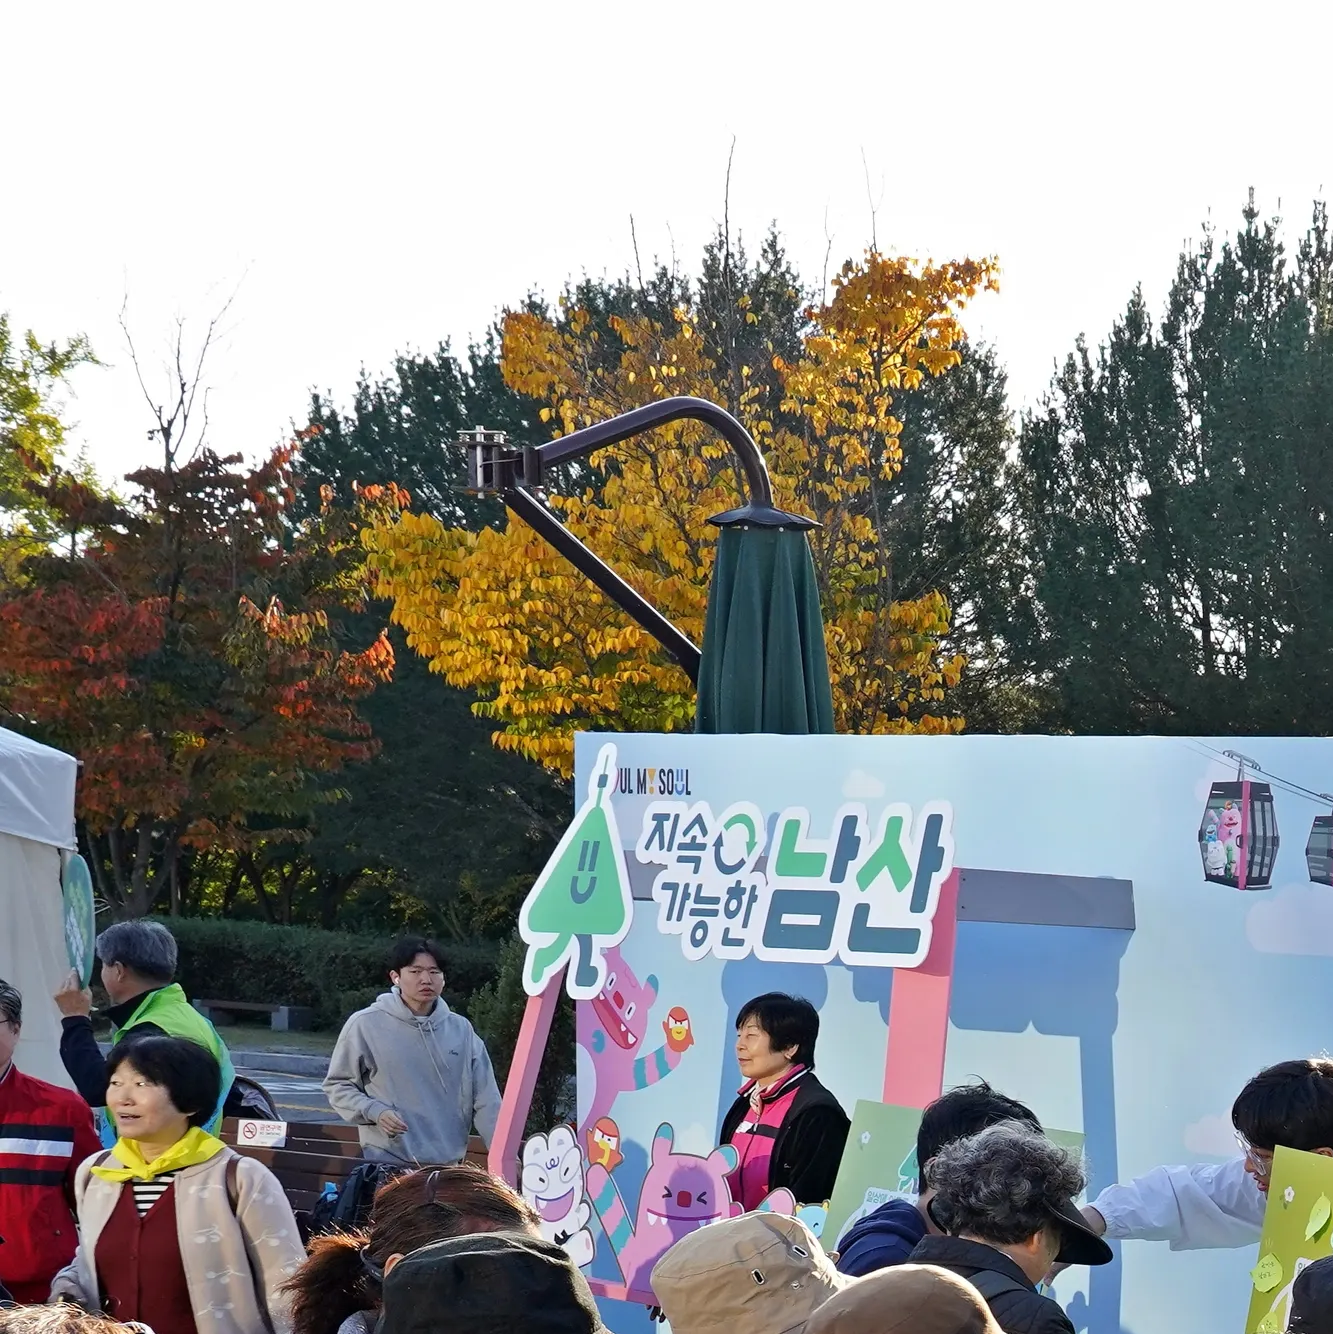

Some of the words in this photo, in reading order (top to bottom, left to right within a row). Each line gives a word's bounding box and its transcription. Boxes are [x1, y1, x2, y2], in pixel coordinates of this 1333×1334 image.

[659, 768, 691, 795] SOUL
[645, 812, 708, 874] 지속
[661, 880, 758, 948] 가능한
[762, 813, 945, 954] 남산
